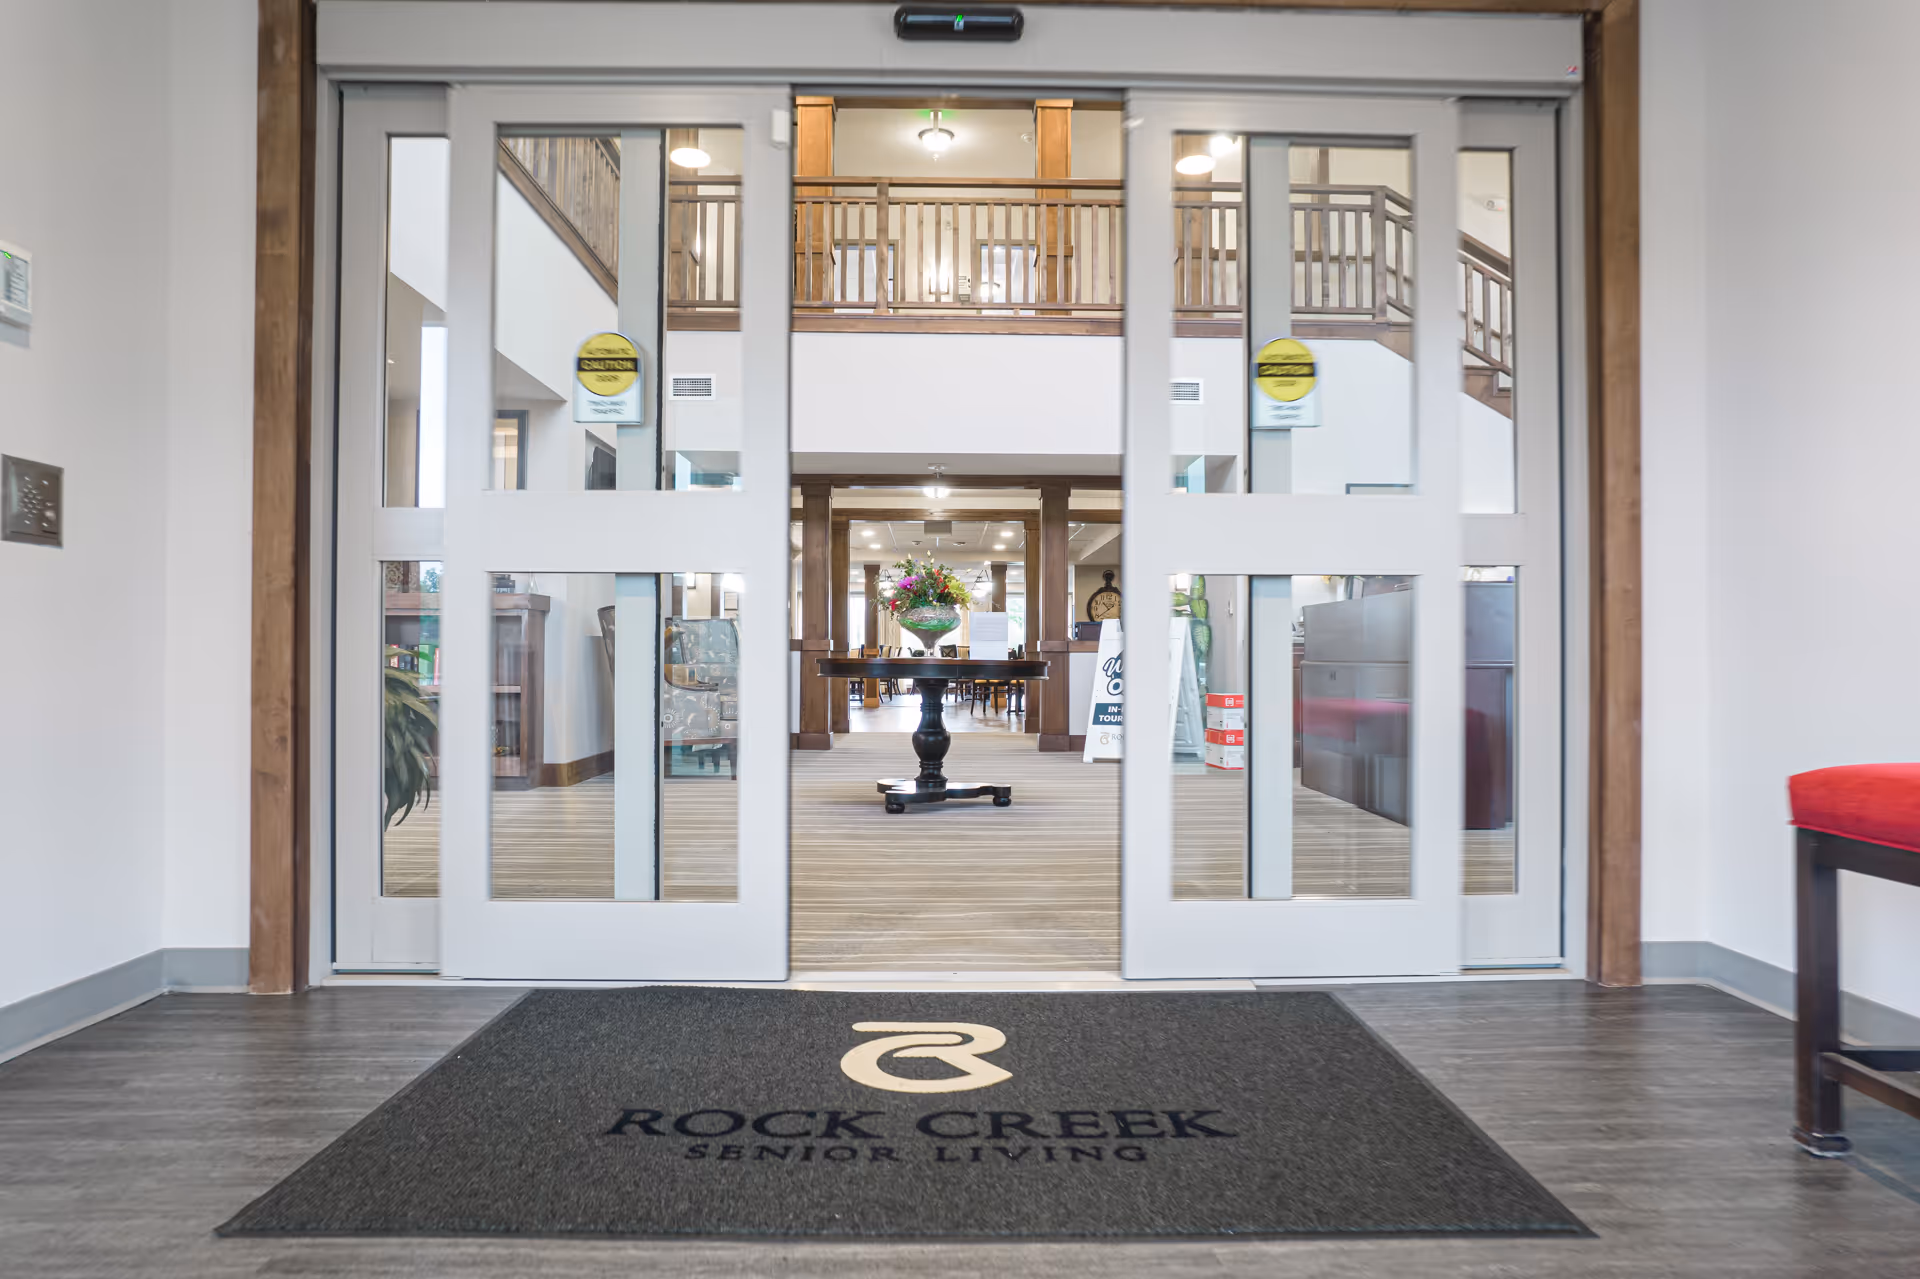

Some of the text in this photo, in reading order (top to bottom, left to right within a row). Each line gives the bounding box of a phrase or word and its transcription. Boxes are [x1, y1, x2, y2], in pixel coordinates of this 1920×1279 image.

[604, 1108, 1239, 1139] ROCK CREEK
[683, 1144, 1148, 1162] SENIOR LIVING
